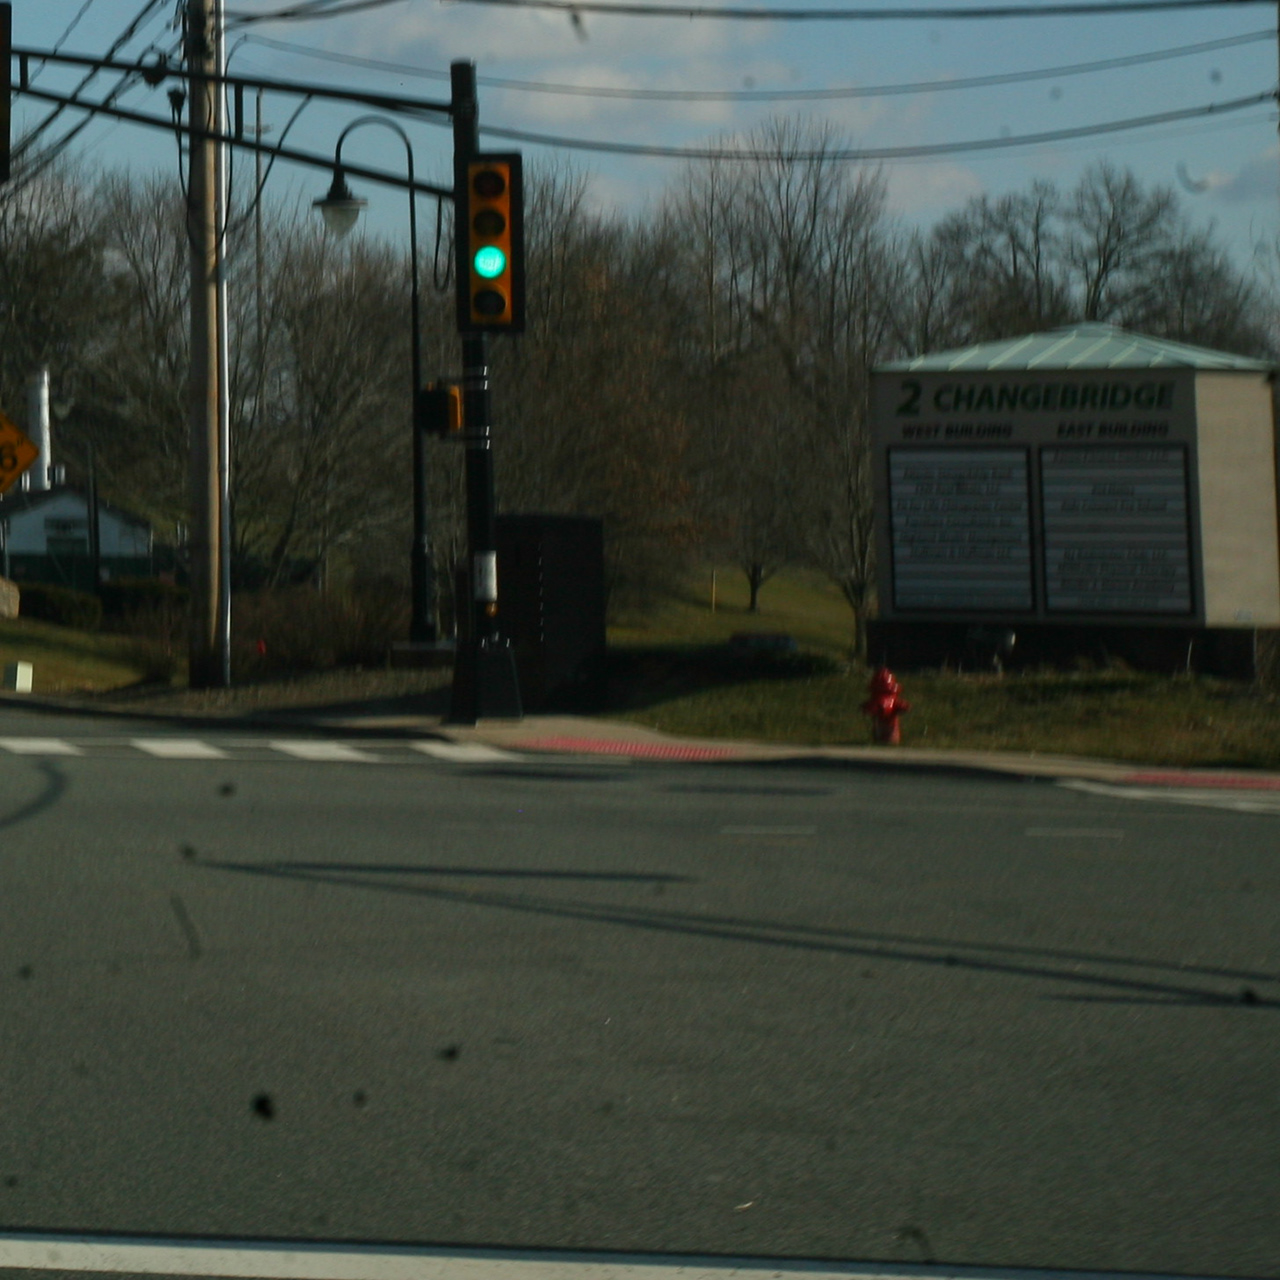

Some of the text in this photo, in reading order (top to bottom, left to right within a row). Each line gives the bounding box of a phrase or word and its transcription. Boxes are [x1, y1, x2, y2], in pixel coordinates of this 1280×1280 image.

[896, 378, 1175, 417] 2 CHANGEBRIDGE
[902, 422, 1013, 439] WEST BUILDING
[1056, 421, 1169, 439] EAST BUILDING
